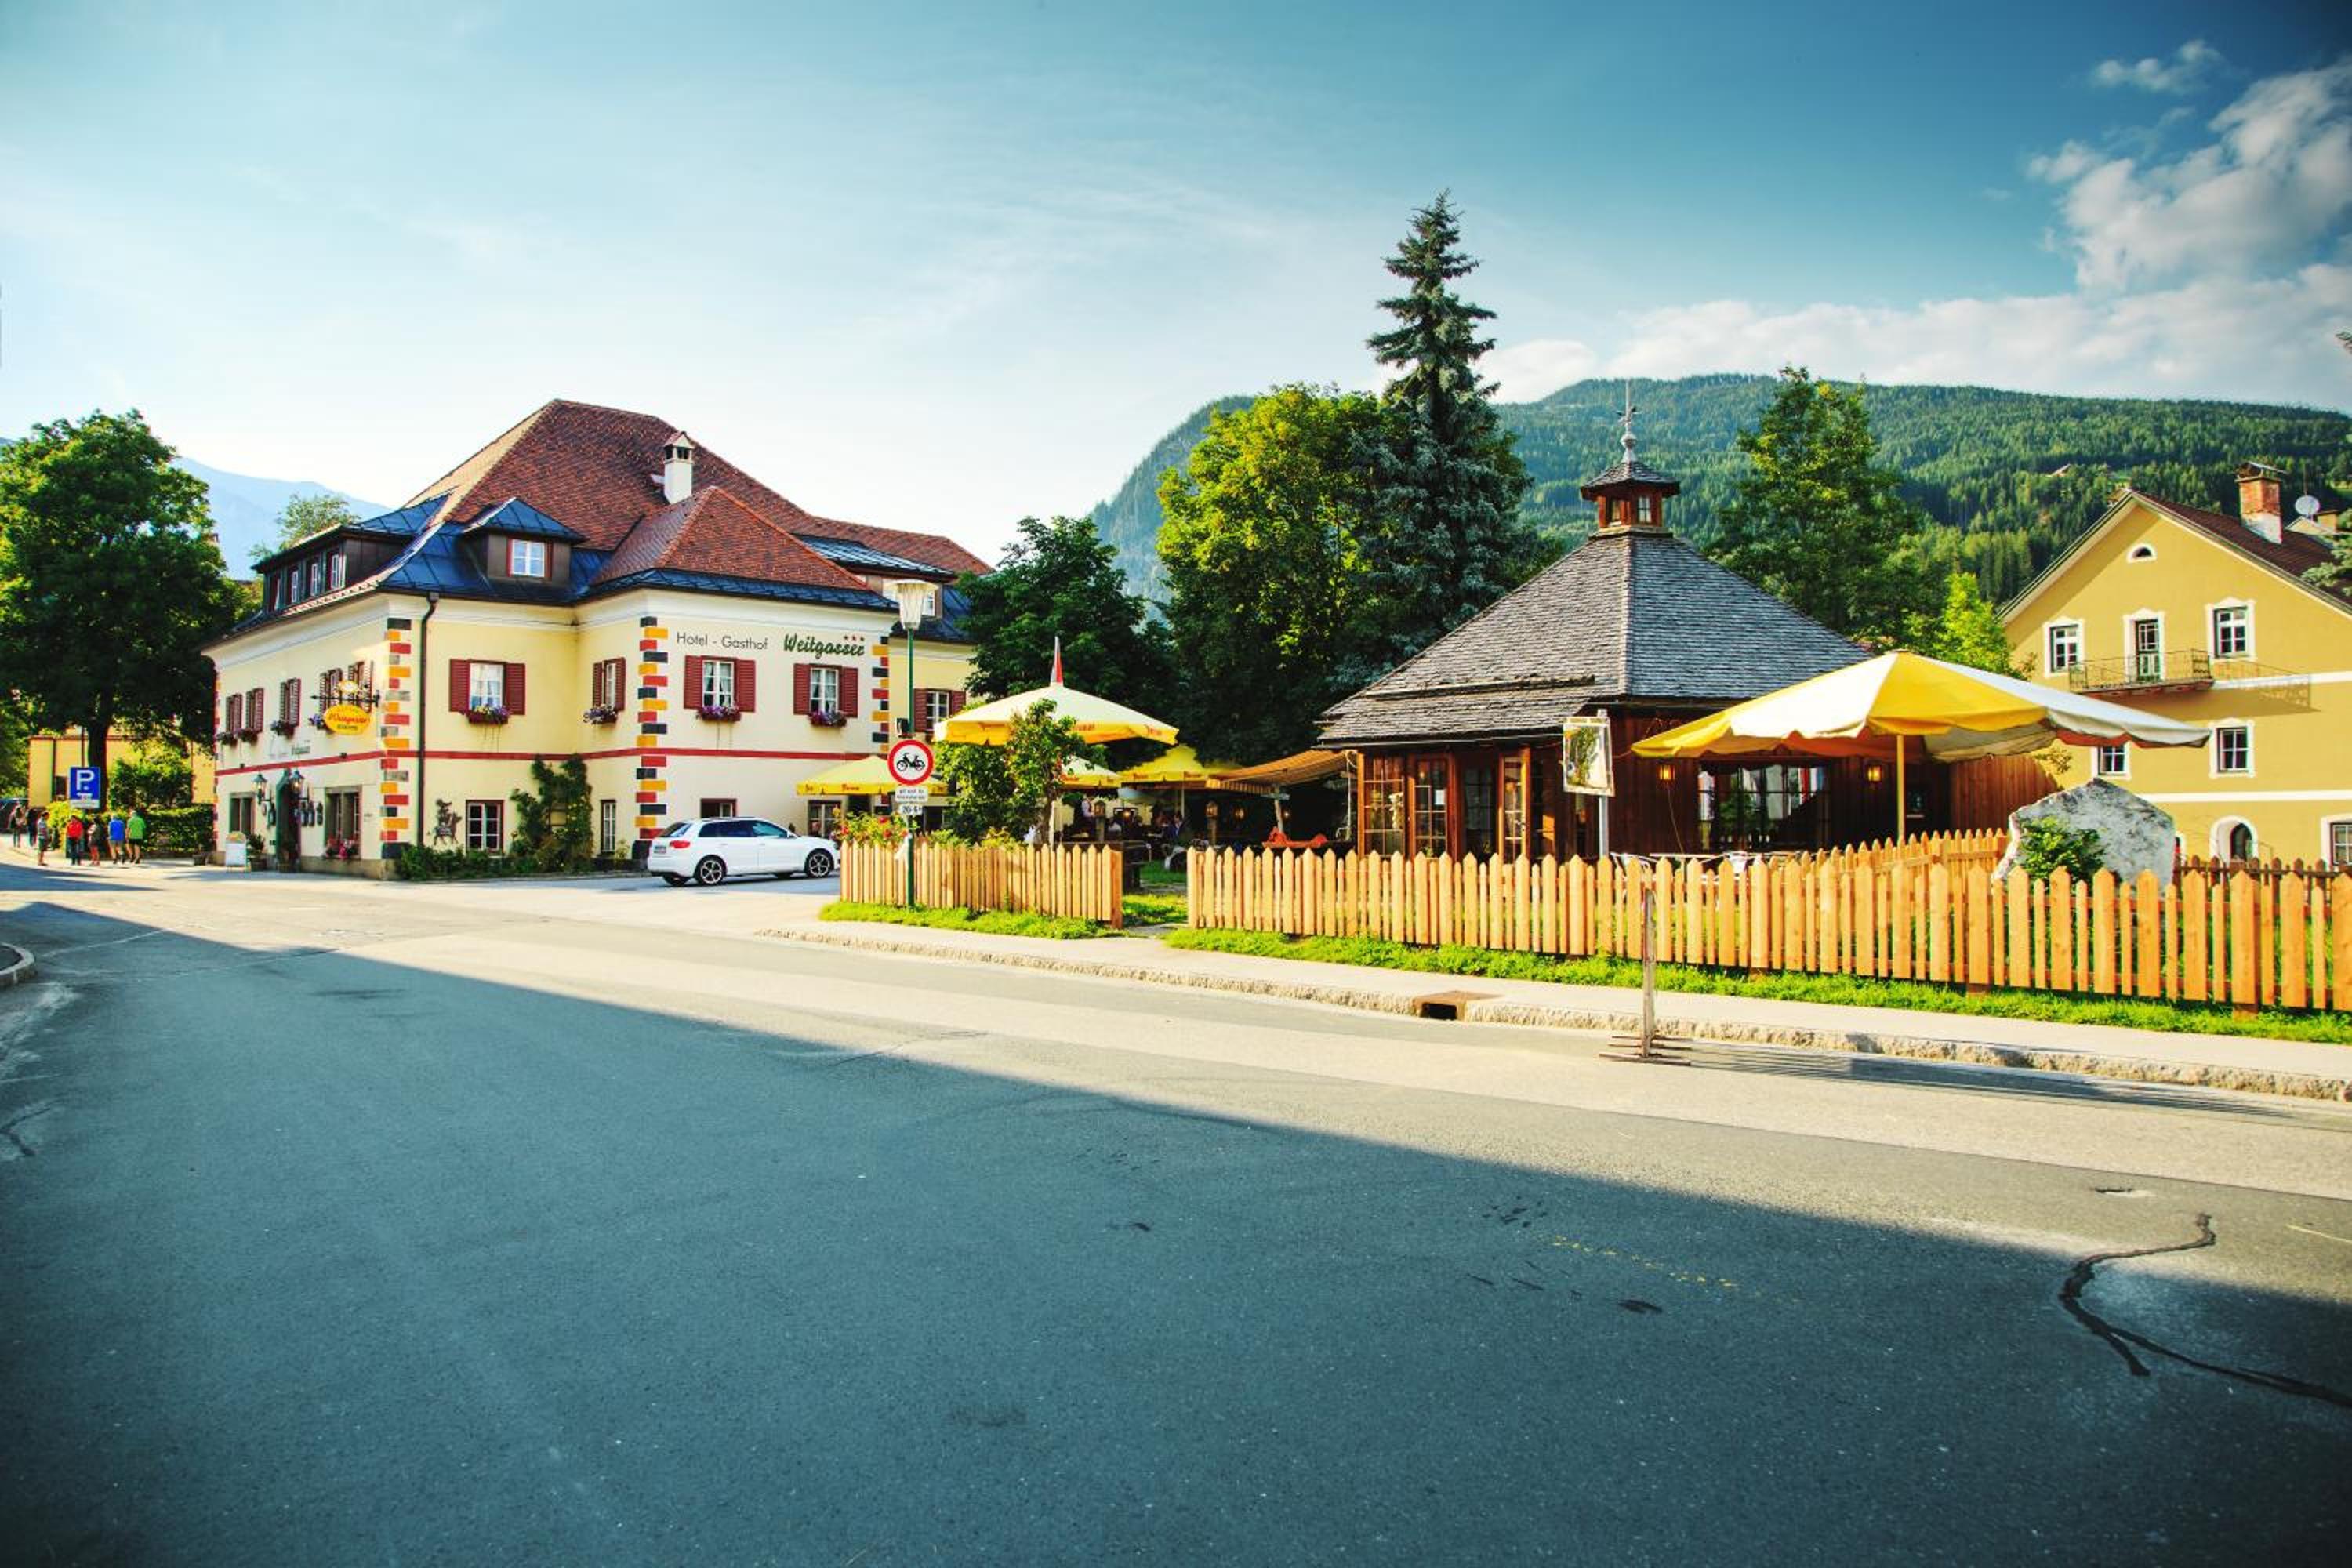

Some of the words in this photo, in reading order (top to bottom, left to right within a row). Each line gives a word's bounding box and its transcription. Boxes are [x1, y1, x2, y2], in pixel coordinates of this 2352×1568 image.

[677, 632, 708, 646] Hotel
[721, 635, 768, 650] Gasthof
[784, 633, 865, 659] Weitgasser
[76, 769, 95, 791] P
